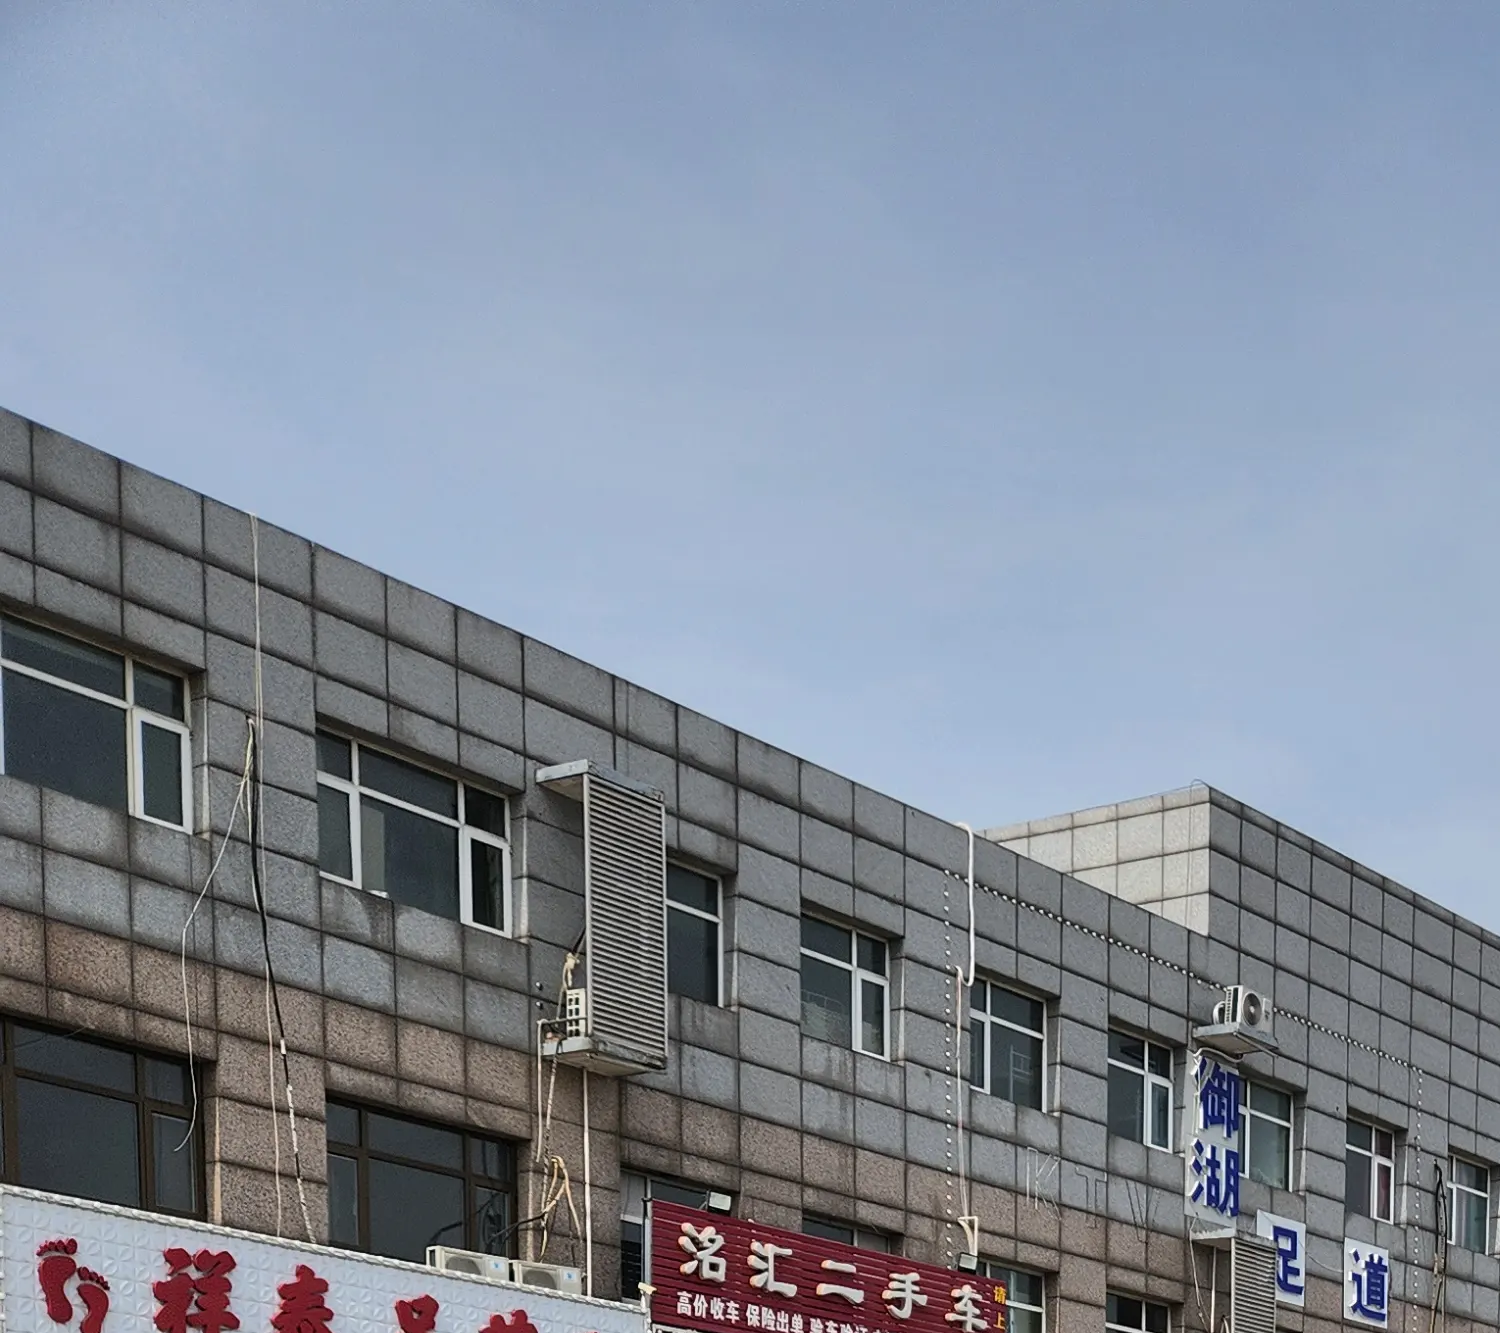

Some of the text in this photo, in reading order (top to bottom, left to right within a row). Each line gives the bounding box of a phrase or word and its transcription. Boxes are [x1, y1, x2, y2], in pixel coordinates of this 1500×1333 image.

[1190, 1055, 1239, 1218] 御湖
[676, 1291, 740, 1324] 高价收车
